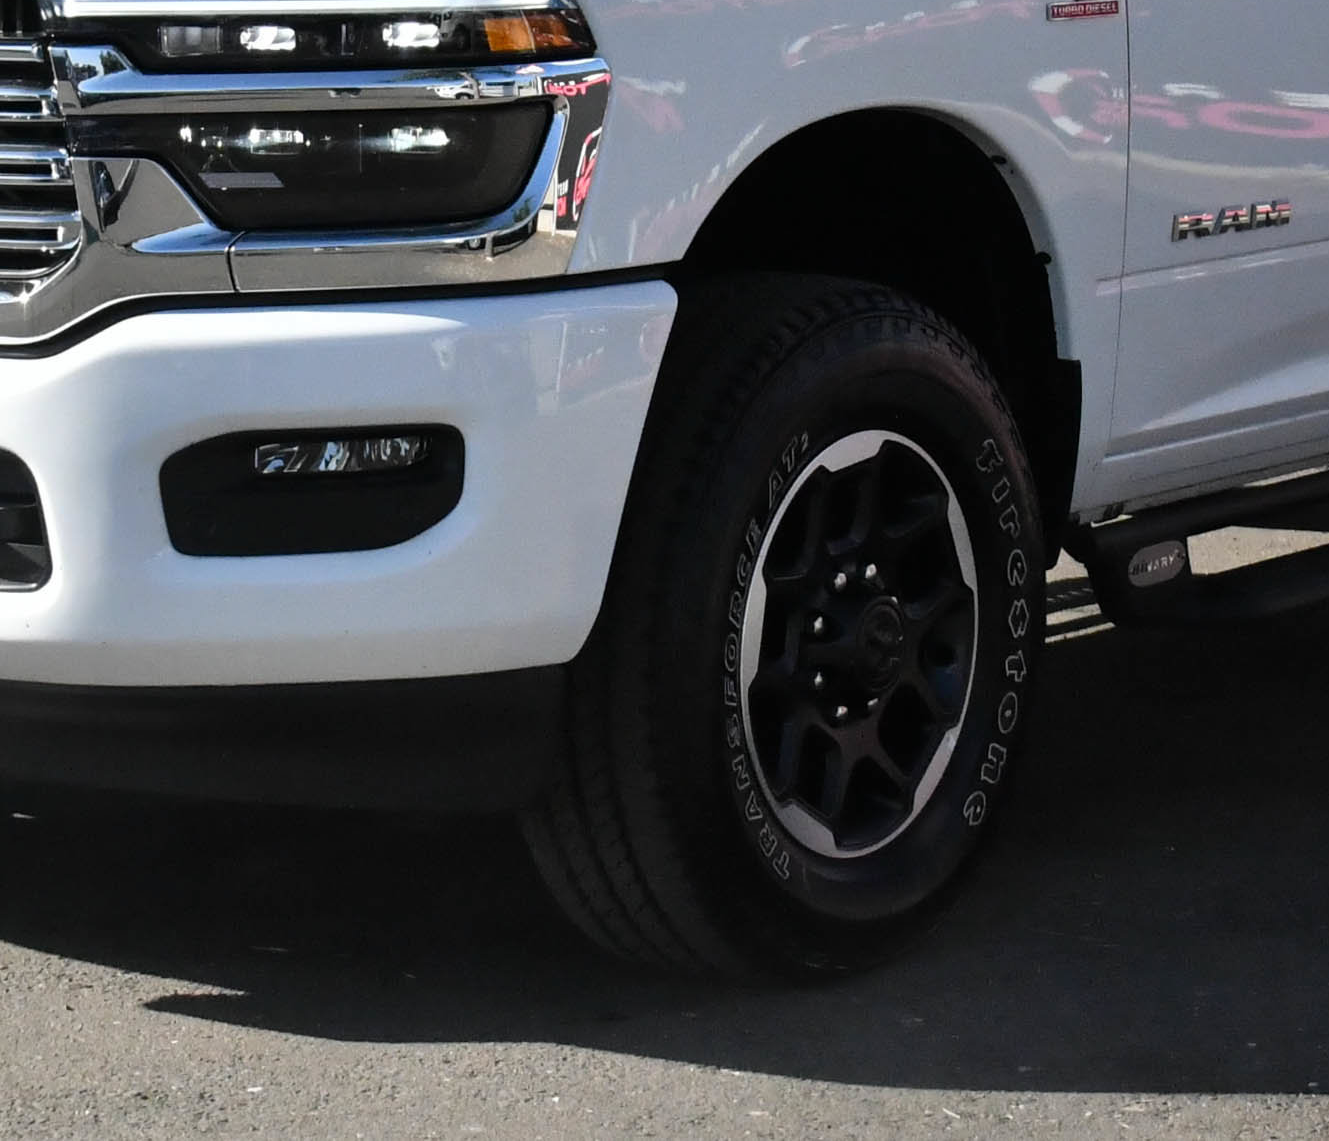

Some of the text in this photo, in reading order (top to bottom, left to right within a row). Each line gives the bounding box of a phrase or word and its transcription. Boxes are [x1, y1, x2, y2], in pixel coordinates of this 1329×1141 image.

[1052, 1, 1118, 18] TURBO DIESEL
[1171, 200, 1290, 242] RAM
